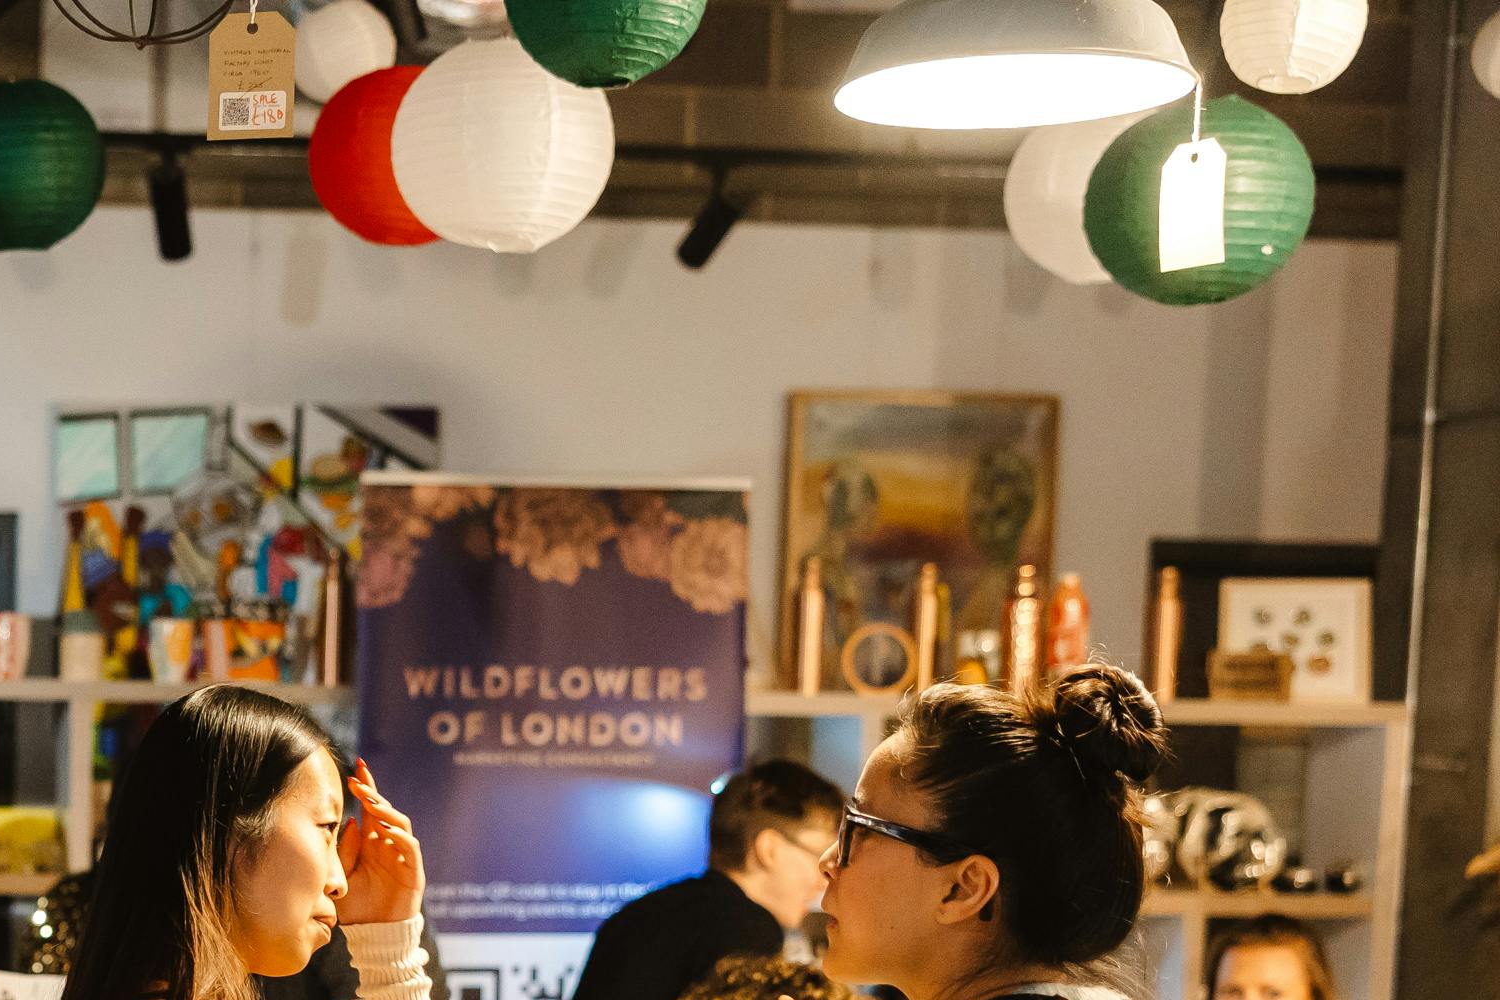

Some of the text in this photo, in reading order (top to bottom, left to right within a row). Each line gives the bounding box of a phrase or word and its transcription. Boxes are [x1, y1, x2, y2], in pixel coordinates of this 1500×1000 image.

[253, 94, 277, 105] SALE
[252, 107, 284, 126] £180
[404, 665, 708, 701] WILDFLOWERS
[427, 709, 684, 748] OF LONDON
